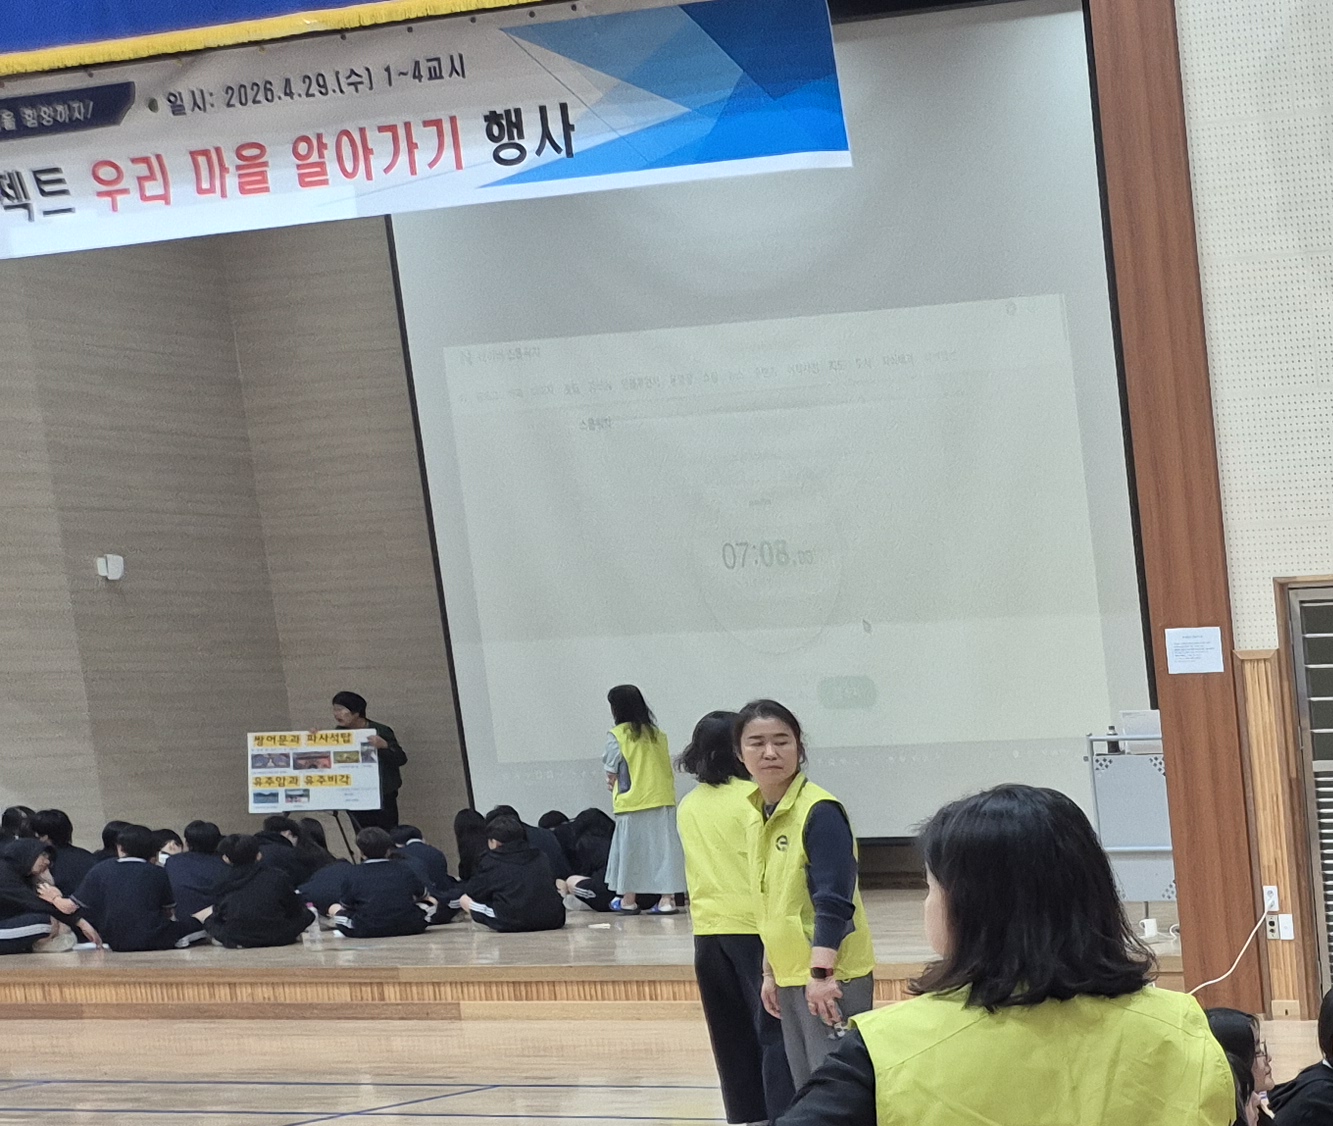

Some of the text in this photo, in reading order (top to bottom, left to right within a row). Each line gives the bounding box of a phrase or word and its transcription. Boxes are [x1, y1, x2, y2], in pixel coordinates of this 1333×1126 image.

[167, 53, 467, 116] 일시: 2026.4.29.(수) 1~4교시
[91, 154, 171, 212] 우리
[189, 141, 271, 199] 마을
[292, 115, 464, 188] 알아가기
[483, 102, 575, 166] 행사
